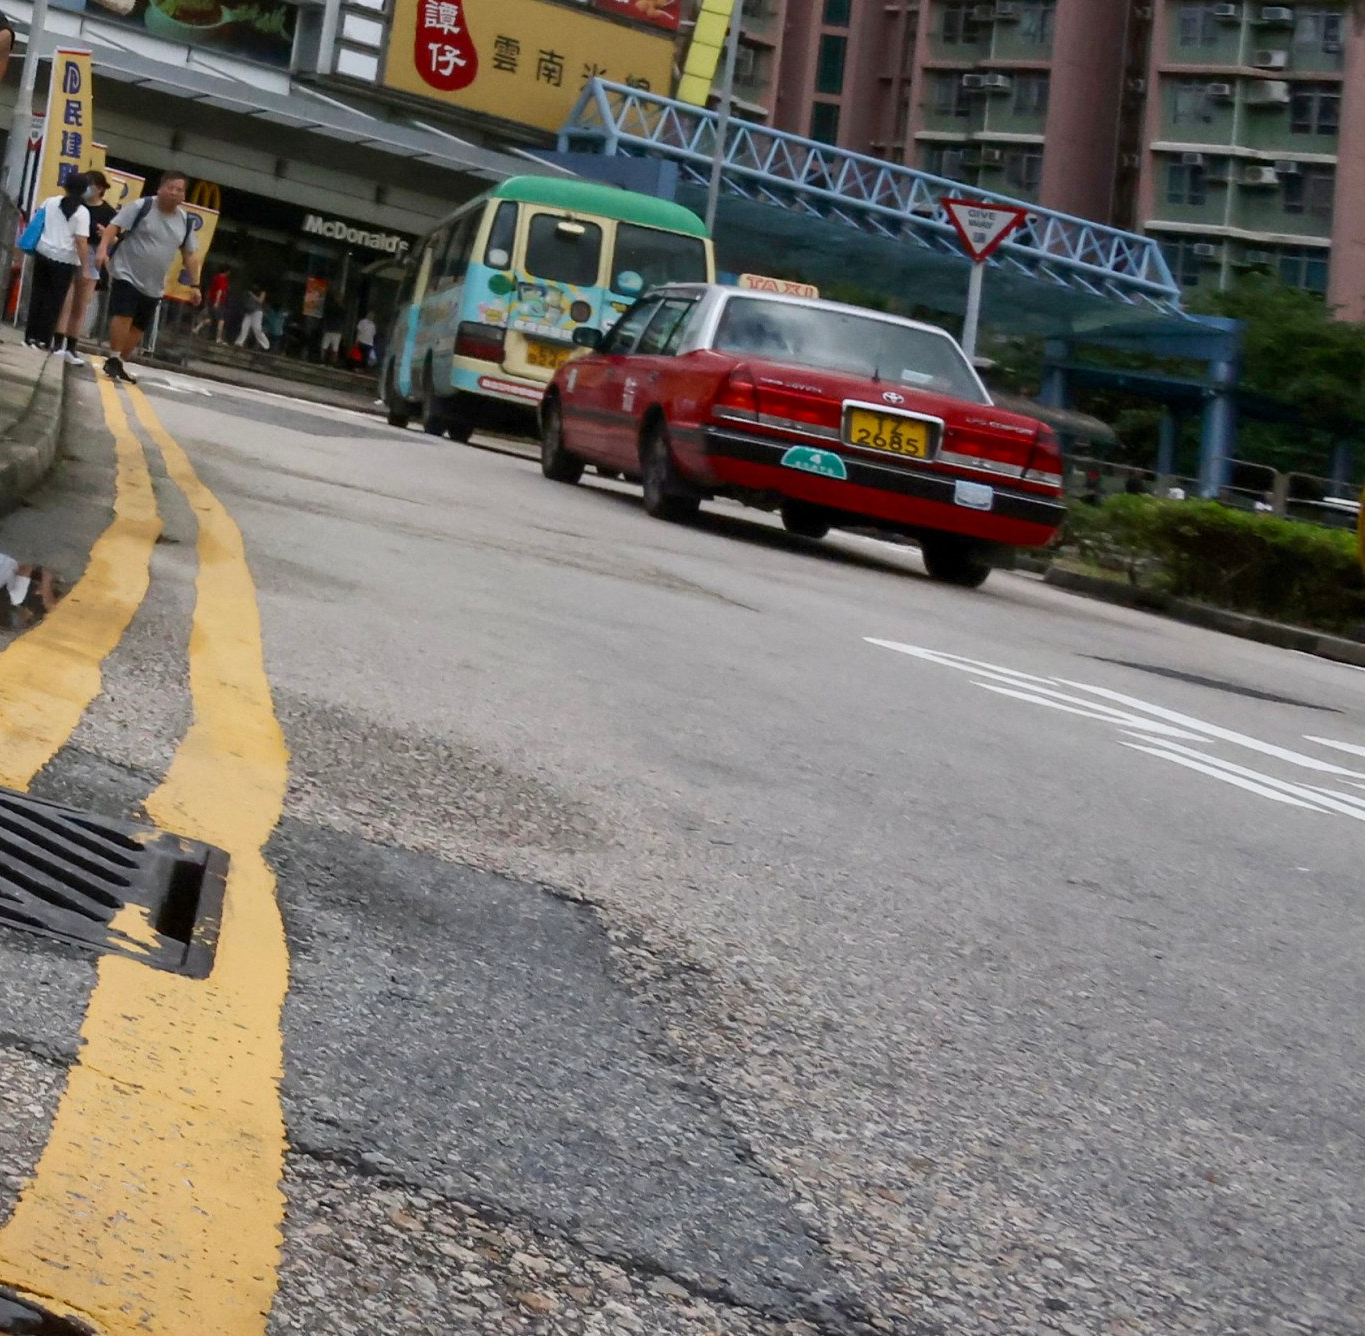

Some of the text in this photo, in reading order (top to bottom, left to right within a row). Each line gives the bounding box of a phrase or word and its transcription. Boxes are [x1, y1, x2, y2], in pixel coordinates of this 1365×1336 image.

[968, 209, 996, 220] GIVE
[746, 275, 815, 298] TAXI
[857, 428, 920, 455] 2685
